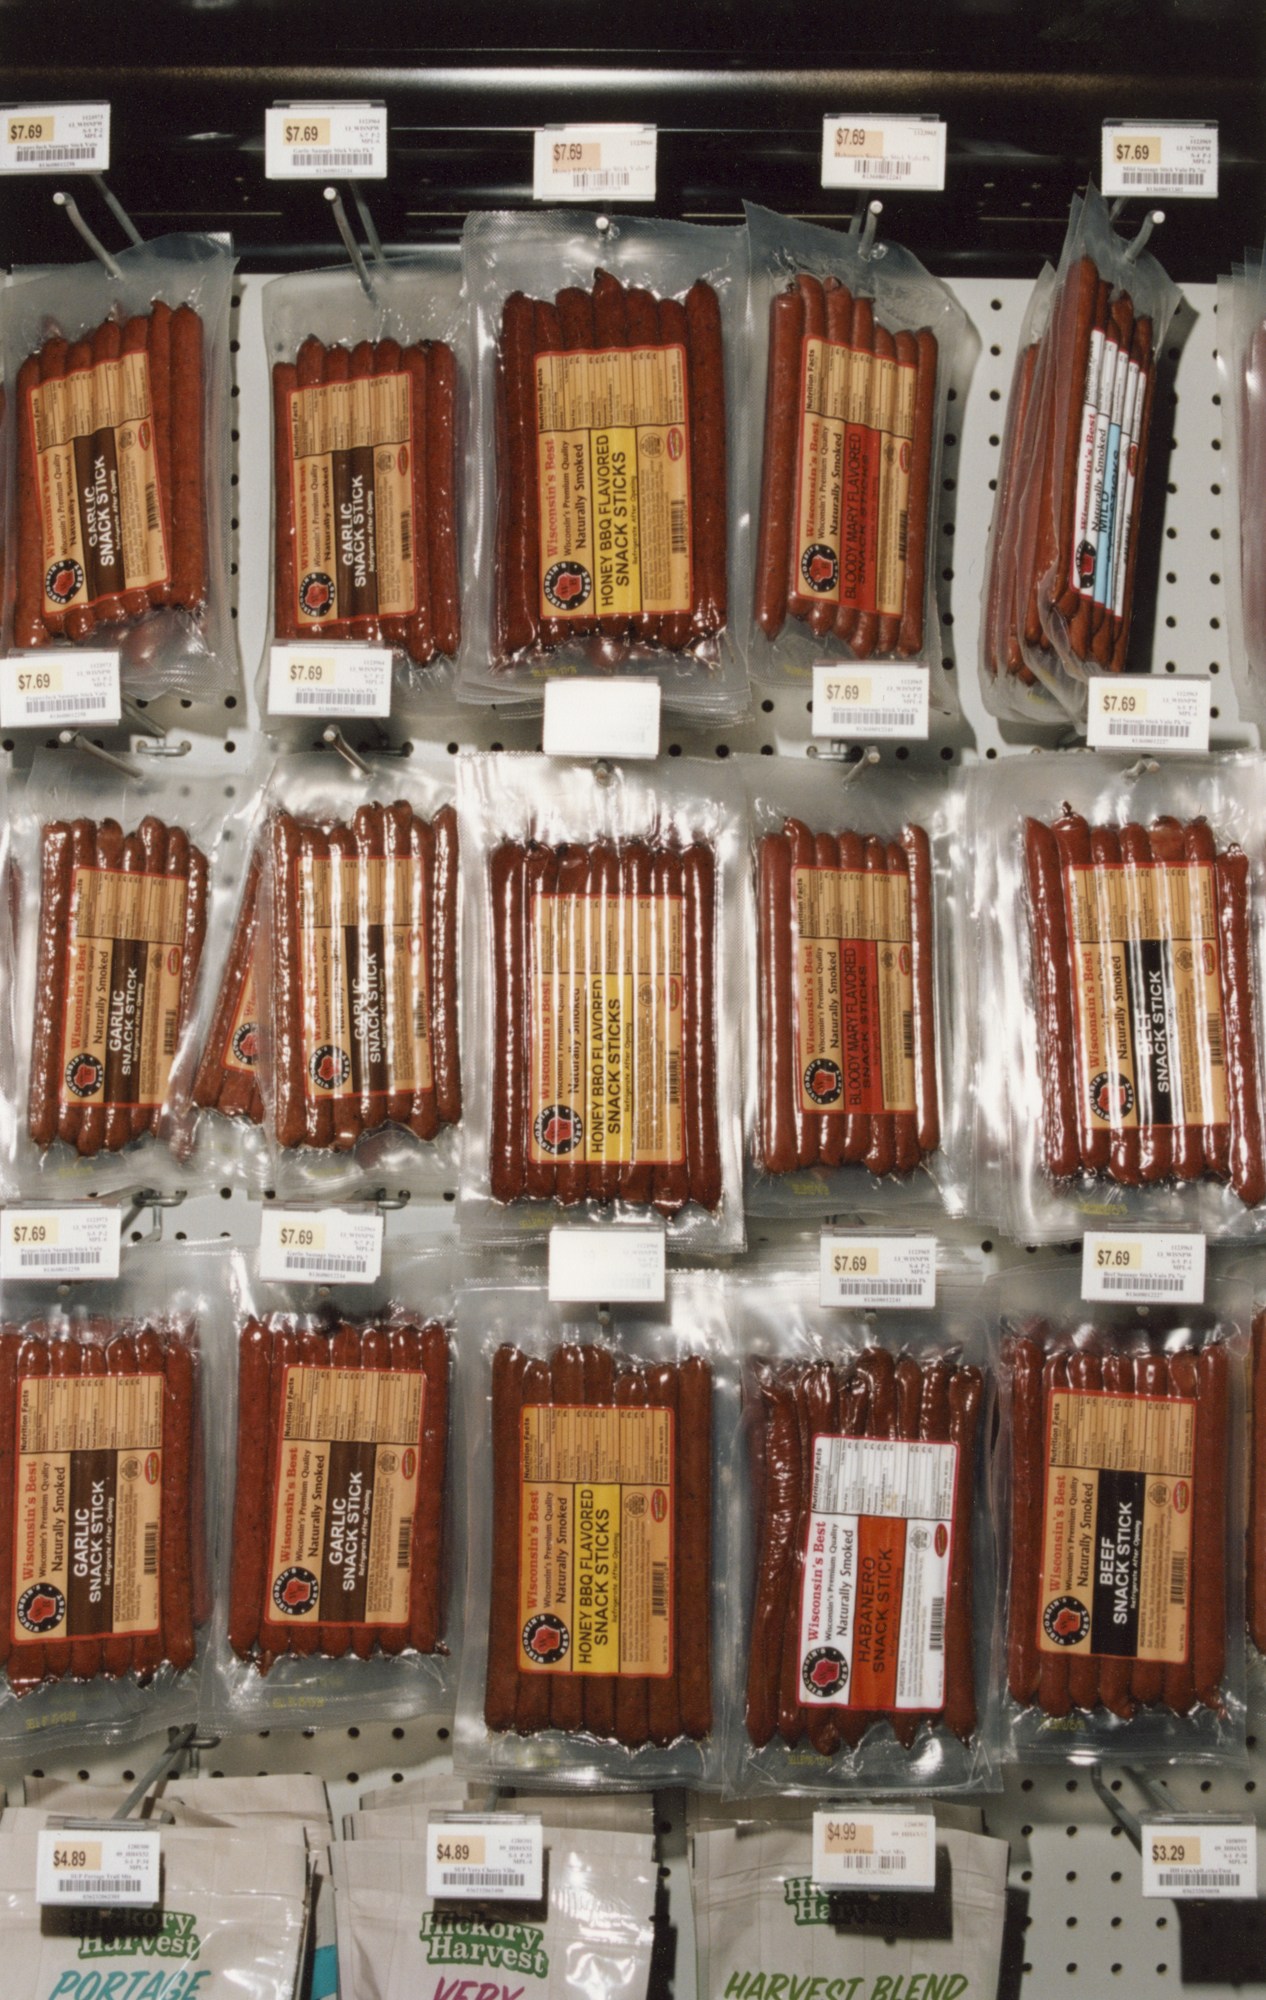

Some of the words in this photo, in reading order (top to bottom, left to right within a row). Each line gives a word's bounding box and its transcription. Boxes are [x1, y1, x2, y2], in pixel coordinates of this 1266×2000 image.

[11, 124, 42, 140] $7.69
[286, 126, 318, 143] $7.69
[553, 144, 583, 163] $7.69
[837, 128, 866, 147] $7.69
[1116, 144, 1149, 160] $7.69
[545, 439, 554, 470] Best
[561, 441, 570, 470] Quality
[809, 422, 819, 452] Best
[831, 433, 842, 478] Smoked
[1096, 430, 1106, 473] Smoked
[94, 456, 108, 503] STICK
[321, 467, 330, 509] Smoked
[562, 472, 570, 508] Premium
[573, 444, 585, 490] Smoked
[596, 435, 610, 514] FLAVORED
[612, 452, 627, 517] STICKS
[849, 433, 860, 500] FLAVORED
[1080, 448, 1092, 530] Wisconsin's
[1086, 414, 1096, 443] Best
[85, 486, 98, 546] GARLIC
[352, 475, 364, 524] STICK
[546, 475, 558, 557] Wisconsin's
[806, 455, 817, 537] Wisconsin's
[829, 482, 841, 536] Naturally
[1092, 479, 1103, 531] Naturally
[100, 508, 115, 566] SNACK
[323, 513, 332, 561] Naturally
[341, 503, 354, 565] GARLIC
[563, 511, 572, 556] Wisconsin's
[575, 495, 587, 549] Naturally
[599, 518, 611, 550] BBQ
[847, 503, 858, 542] MARY
[354, 529, 367, 587] SNACK
[614, 523, 629, 586] SNACK
[846, 545, 857, 599] BLOODY
[601, 556, 613, 606] HONEY
[18, 674, 50, 690] $7.69
[290, 664, 322, 681] $7.69
[826, 684, 859, 700] $7.69
[1103, 694, 1135, 711] $7.69
[76, 944, 86, 972] Best
[96, 952, 108, 992] Smoked
[320, 937, 328, 962] Quality
[805, 945, 813, 973] Best
[828, 952, 837, 994] Smoked
[1082, 951, 1093, 980] Best
[125, 967, 137, 1014] STICK
[365, 953, 378, 1000] STICK
[542, 981, 550, 1011] Best
[844, 949, 857, 1013] FLAVORED
[859, 965, 868, 1019] STICKS
[1111, 956, 1123, 1001] Smoked
[1149, 971, 1164, 1023] STICK
[71, 980, 85, 1049] Wisconsin's
[93, 996, 107, 1044] Naturally
[109, 990, 125, 1050] GARLIC
[367, 1006, 381, 1062] SNACK
[591, 980, 603, 1060] FLAVORED
[608, 999, 620, 1064] STICKS
[806, 977, 815, 1054] Wisconsin's
[828, 999, 839, 1048] Naturally
[847, 1016, 858, 1051] MARY
[1086, 986, 1099, 1068] Wisconsin's
[1114, 1006, 1128, 1059] Naturally
[122, 1020, 133, 1075] SNACK
[568, 1040, 581, 1094] Naturally
[861, 1033, 871, 1088] SNACK
[1154, 1030, 1169, 1093] SNACK
[608, 1070, 621, 1134] SNACK
[848, 1055, 861, 1105] BLOODY
[592, 1102, 604, 1153] HONEY
[14, 1226, 45, 1242] $7.69
[281, 1228, 313, 1245] $7.69
[1097, 1249, 1129, 1266] $7.69
[834, 1255, 866, 1271] $7.69
[287, 1447, 298, 1477] Best
[1050, 1428, 1058, 1463] Nutrition
[25, 1461, 36, 1490] Best
[41, 1462, 50, 1491] Quality
[53, 1467, 66, 1513] Smoked
[311, 1455, 324, 1500] Smoked
[347, 1472, 362, 1523] STICK
[1054, 1475, 1066, 1505] Best
[1069, 1477, 1078, 1506] Quality
[40, 1493, 49, 1529] Premium
[91, 1480, 104, 1533] STICK
[281, 1482, 296, 1562] Wisconsin's
[529, 1491, 539, 1521] Best
[545, 1492, 554, 1521] Quality
[556, 1497, 568, 1544] Smoked
[580, 1489, 593, 1570] FLAVORED
[1067, 1508, 1077, 1543] Premium
[1080, 1483, 1093, 1529] Smoked
[1117, 1502, 1132, 1555] STICK
[23, 1497, 36, 1580] Wisconsin's
[39, 1532, 48, 1577] Wisconsin's
[52, 1518, 65, 1572] Naturally
[74, 1509, 89, 1577] GARLIC
[308, 1505, 322, 1557] Naturally
[329, 1498, 346, 1565] GARLIC
[544, 1523, 553, 1559] Premium
[595, 1509, 609, 1575] STICKS
[813, 1521, 826, 1553] Best
[829, 1523, 839, 1553] Quality
[841, 1530, 853, 1576] Smoked
[1050, 1510, 1065, 1592] Wisconsin's
[90, 1539, 103, 1603] SNACK
[343, 1529, 358, 1591] SNACK
[528, 1526, 538, 1609] Wisconsin's
[556, 1550, 568, 1603] Naturally
[827, 1556, 836, 1593] Premium
[877, 1548, 891, 1603] STICK
[1065, 1546, 1074, 1591] Wisconsin's
[1078, 1534, 1092, 1587] Naturally
[1100, 1536, 1115, 1585] BEEF
[544, 1562, 552, 1608] Wisconsin's
[580, 1575, 593, 1606] BBQ
[808, 1558, 823, 1641] Wisconsin's
[837, 1581, 852, 1636] Naturally
[1114, 1560, 1130, 1624] SNACK
[1130, 1570, 1138, 1609] Refrigerate
[594, 1581, 608, 1645] SNACK
[824, 1595, 834, 1641] Wisconsin's
[859, 1556, 874, 1662] HABANERO
[1080, 1610, 1089, 1637] BEST
[579, 1611, 592, 1663] HONEY
[873, 1608, 888, 1673] SNACK
[437, 1843, 469, 1861] $4.89
[827, 1821, 857, 1842] $4.99
[1152, 1844, 1185, 1862] $3.29
[53, 1850, 86, 1867] $4.89
[423, 1912, 540, 1950] Hickory
[429, 1937, 545, 1972] Harvest
[48, 1970, 212, 2000] PORTAGE
[724, 1971, 865, 2000] HARVEST
[871, 1973, 969, 2000] BLEND
